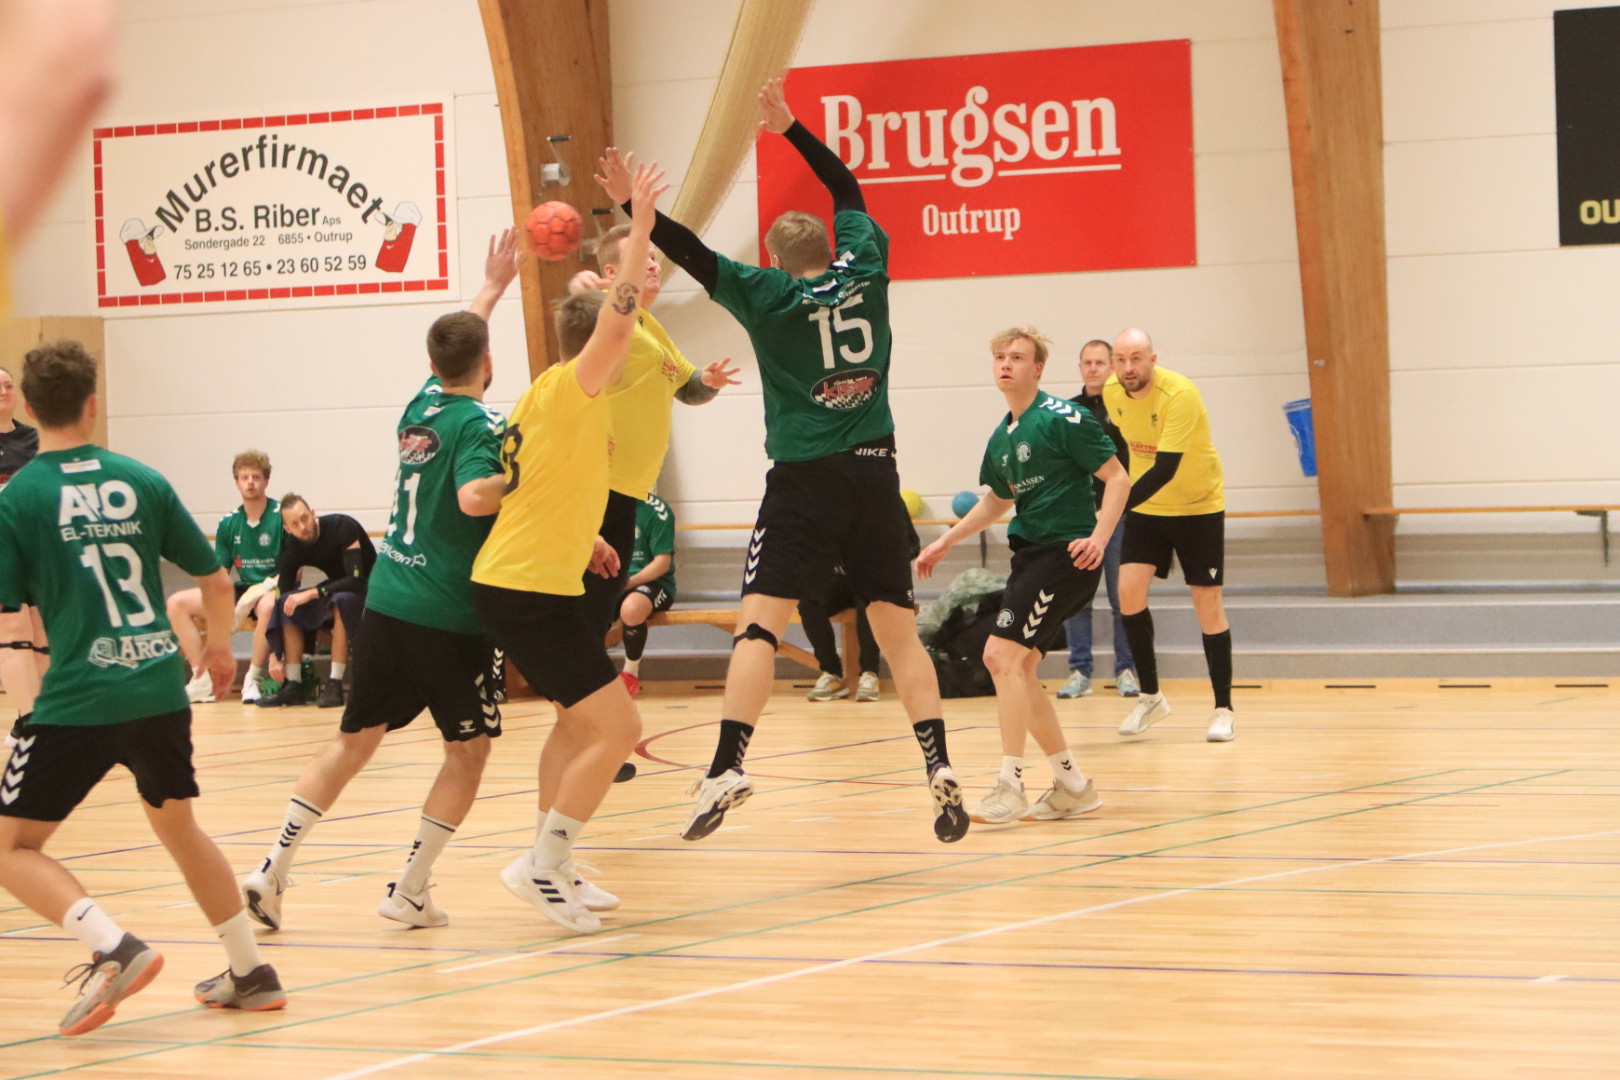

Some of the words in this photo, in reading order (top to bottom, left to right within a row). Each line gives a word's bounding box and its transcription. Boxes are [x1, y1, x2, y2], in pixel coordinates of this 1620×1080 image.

[821, 85, 1122, 187] Brugsen
[155, 134, 383, 234] Murerfirmaet
[195, 206, 244, 233] B.S.
[254, 203, 320, 230] Riber
[322, 215, 342, 227] Aps
[922, 203, 1021, 239] Outrup
[184, 236, 250, 251] Søndergade
[252, 235, 265, 246] 22
[278, 232, 304, 245] 6855
[314, 231, 353, 243] Outrup
[174, 264, 192, 280] 75
[197, 262, 215, 279] 25
[221, 260, 238, 277] 12
[243, 260, 261, 277] 65
[277, 258, 295, 274] 23
[300, 257, 319, 273] 60
[324, 255, 342, 272] 52
[348, 254, 366, 271] 59
[808, 293, 874, 369] 15
[60, 521, 142, 542] EL-TEKNIK
[80, 543, 156, 628] 13
